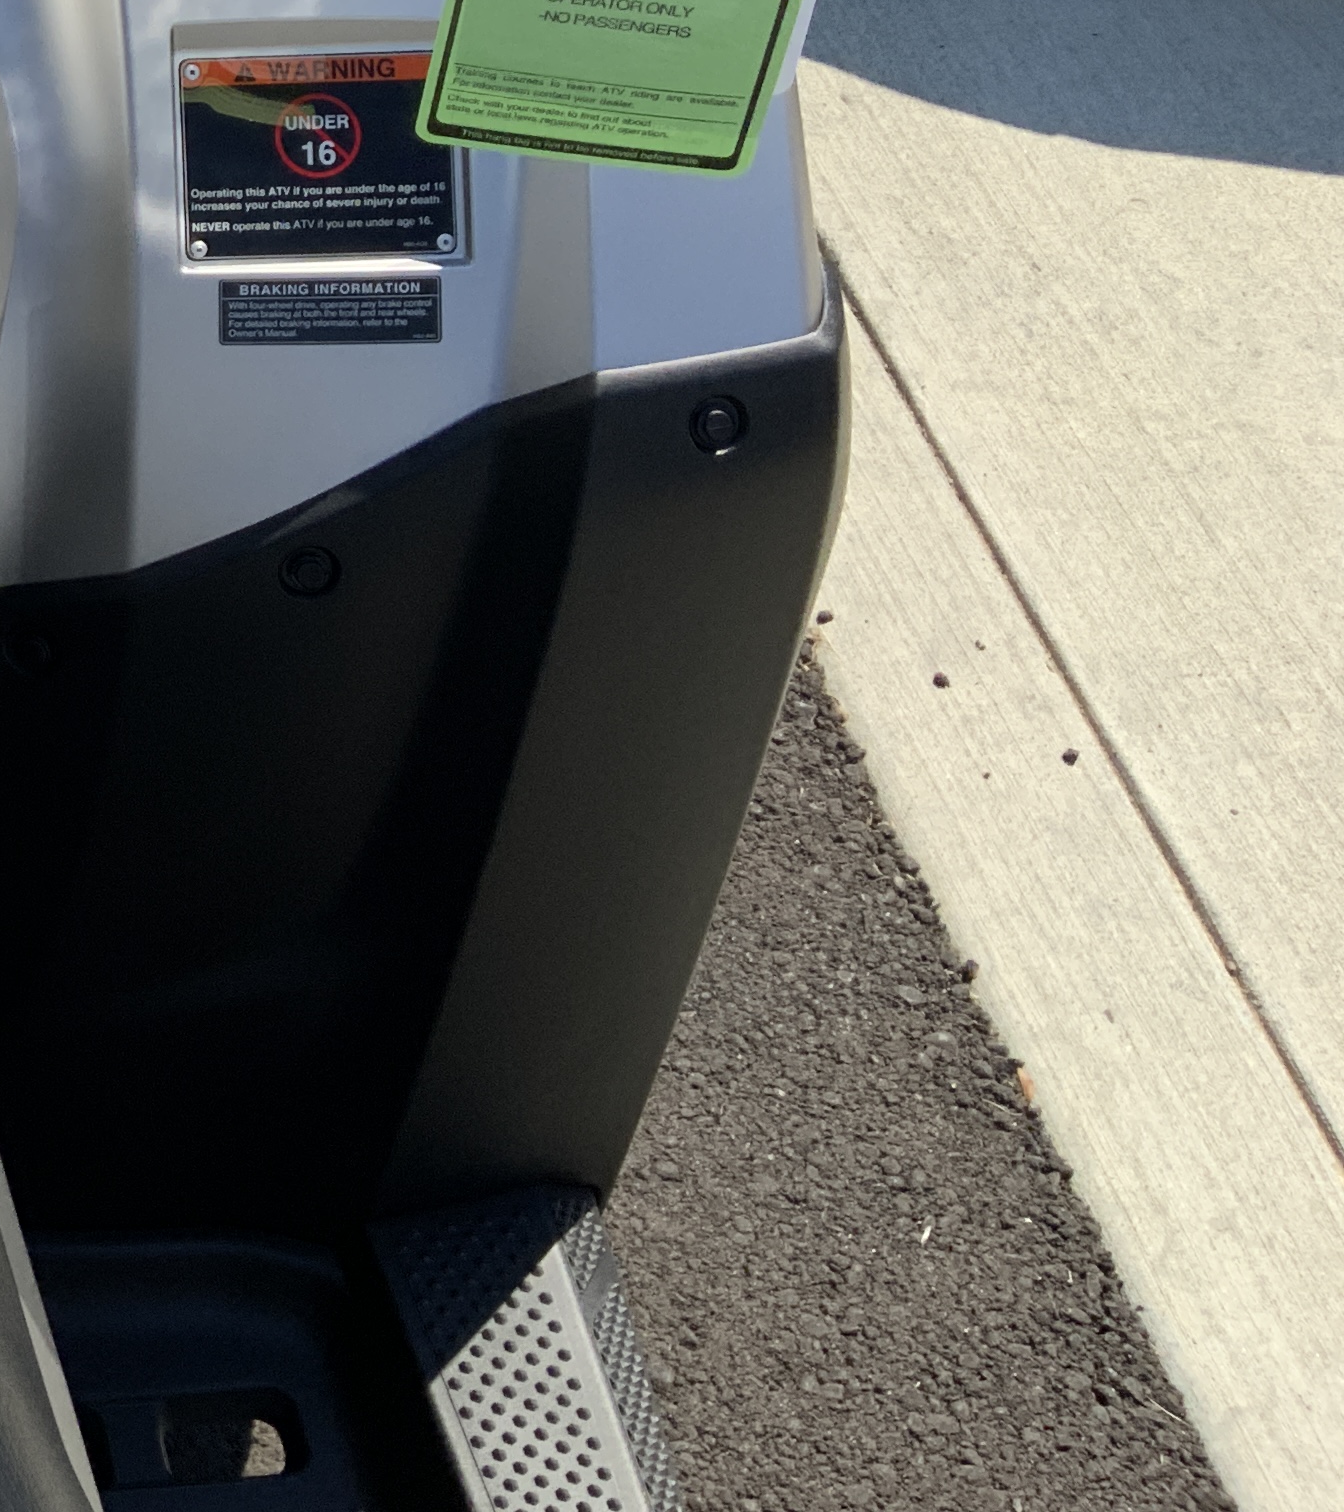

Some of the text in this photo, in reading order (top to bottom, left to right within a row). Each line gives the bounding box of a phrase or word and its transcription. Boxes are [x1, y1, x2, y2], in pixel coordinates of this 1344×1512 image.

[647, 1, 692, 16] ONLY
[574, 13, 691, 37] PASSENGERS
[268, 59, 395, 81] WARNING
[285, 113, 349, 130] UNDER
[302, 142, 336, 165] 16
[191, 187, 242, 200] Operating
[245, 186, 265, 196] this
[268, 186, 290, 196] ATV
[293, 185, 299, 195] if
[302, 186, 322, 196] you
[344, 183, 375, 193] under
[378, 182, 395, 192] the
[397, 184, 416, 193] age
[420, 181, 429, 191] of
[433, 181, 445, 190] 16
[191, 200, 241, 210] increases
[245, 201, 268, 211] your
[271, 198, 309, 208] chance
[312, 198, 322, 207] of
[326, 199, 360, 207] severe
[364, 196, 393, 208] injury
[192, 221, 229, 232] NEVER
[232, 220, 270, 232] operate
[273, 220, 290, 229] this
[293, 219, 314, 229] ATV
[317, 219, 322, 228] if
[326, 220, 343, 230] you
[365, 217, 393, 227] under
[396, 218, 414, 228] age
[418, 216, 433, 226] 16.
[240, 283, 419, 295] BRAKING INFORMATION
